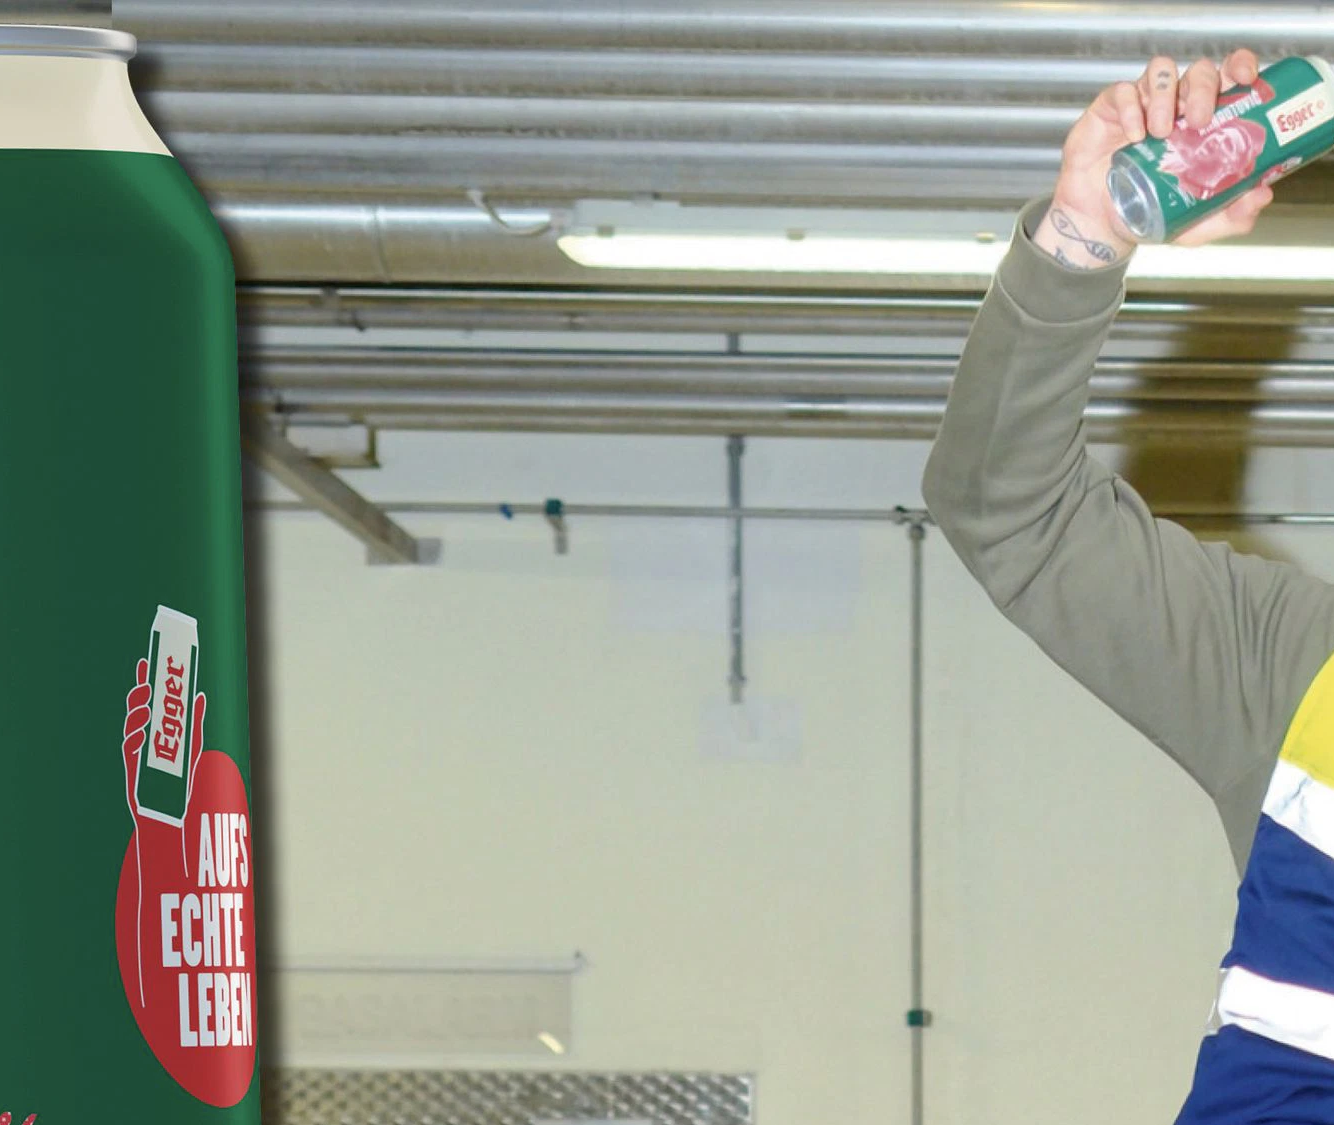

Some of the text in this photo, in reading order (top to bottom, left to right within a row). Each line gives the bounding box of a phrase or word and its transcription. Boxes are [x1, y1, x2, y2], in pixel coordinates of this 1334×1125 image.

[1276, 101, 1316, 133] Egger
[153, 655, 185, 764] Egger
[198, 812, 249, 888] AUFS
[160, 892, 245, 968] ECHTE
[178, 972, 253, 1048] LEBEN
